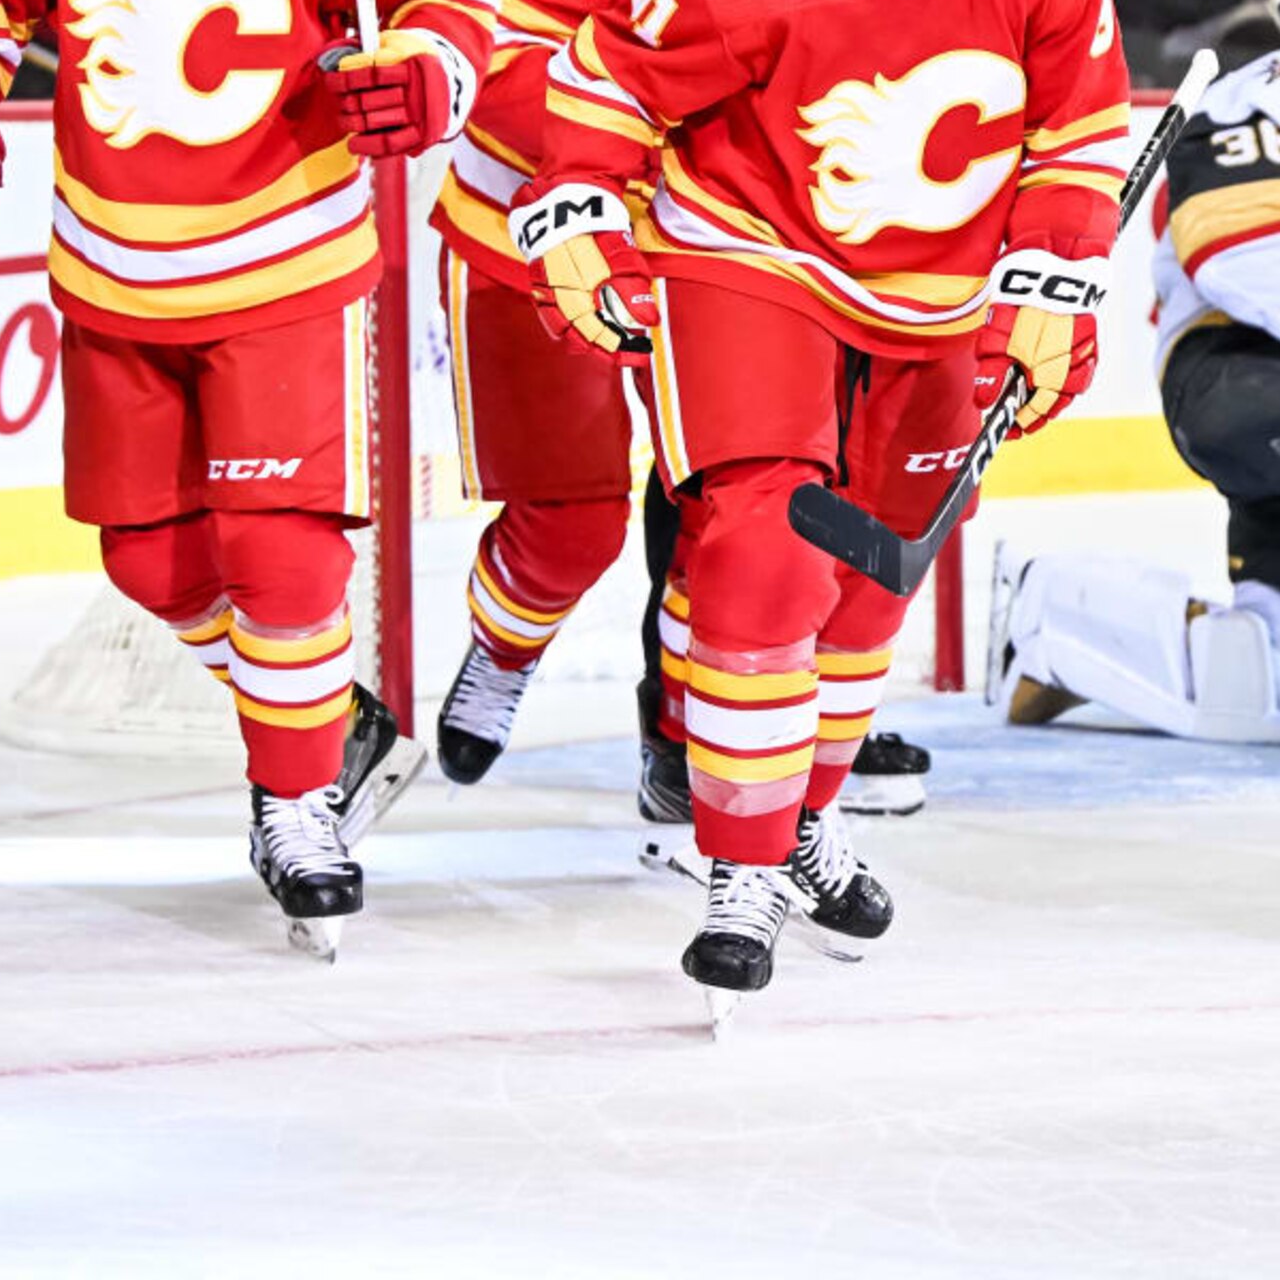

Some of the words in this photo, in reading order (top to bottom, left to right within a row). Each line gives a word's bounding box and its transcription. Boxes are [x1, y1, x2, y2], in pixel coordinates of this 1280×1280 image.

[518, 195, 603, 250] CM
[999, 268, 1107, 308] CCM
[207, 457, 303, 480] CCM
